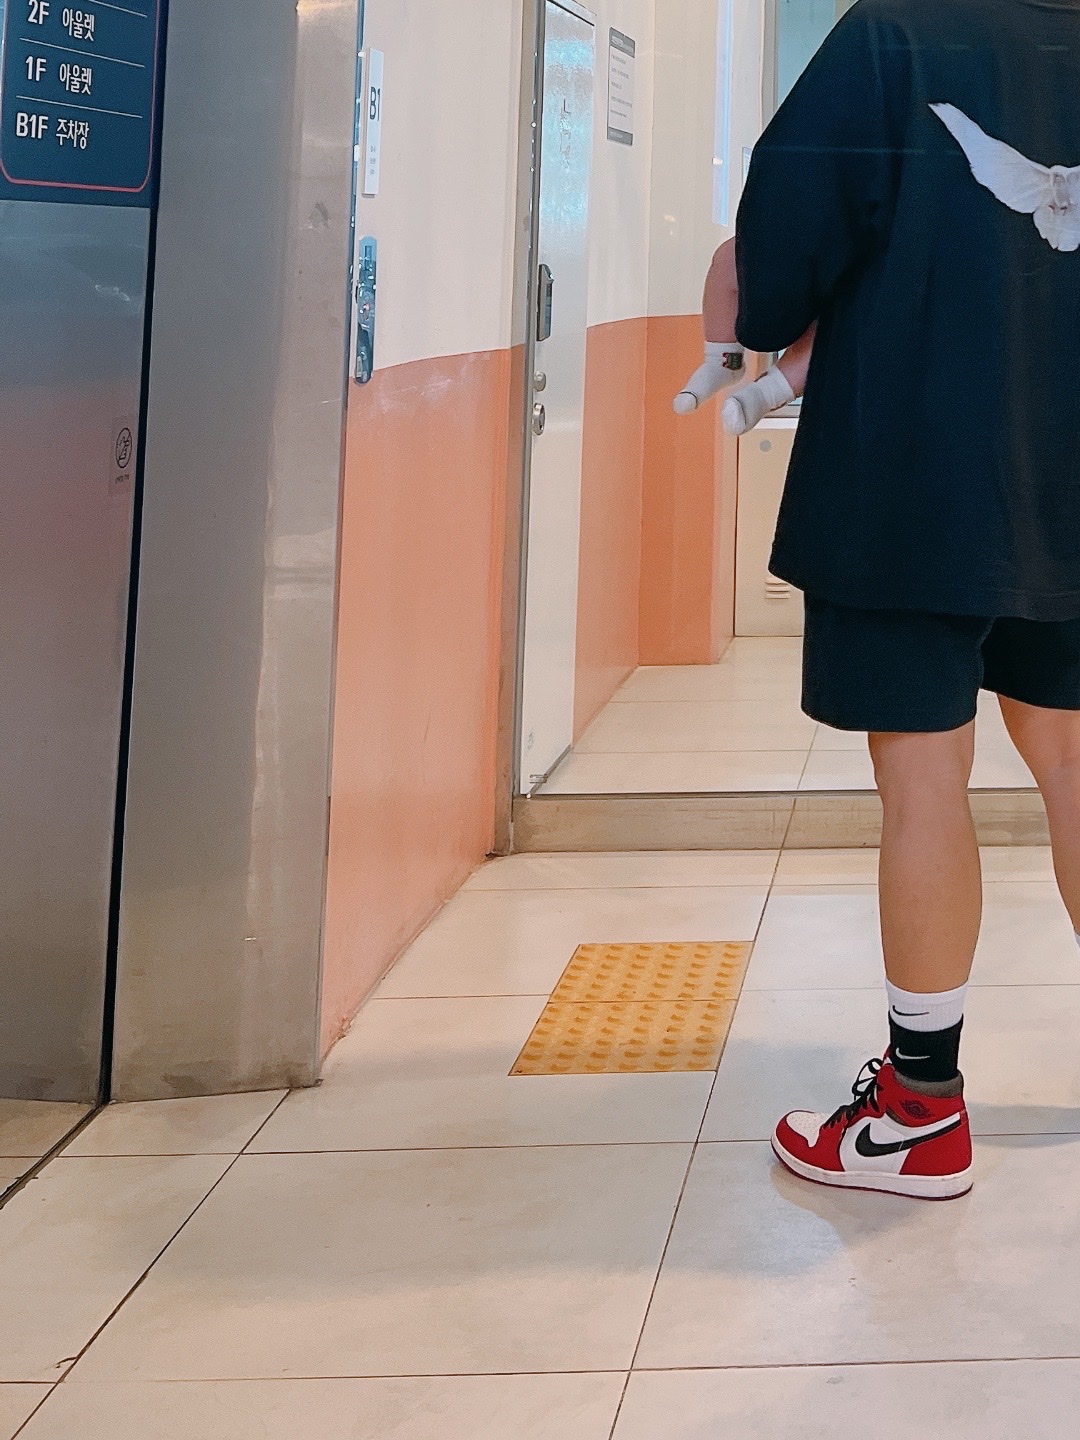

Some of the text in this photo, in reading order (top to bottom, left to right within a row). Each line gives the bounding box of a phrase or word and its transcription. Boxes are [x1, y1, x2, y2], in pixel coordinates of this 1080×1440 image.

[62, 8, 95, 42] 아울렛
[25, 56, 92, 95] 1F 아울렛
[369, 86, 381, 122] B1
[16, 112, 90, 150] B1F 주차장
